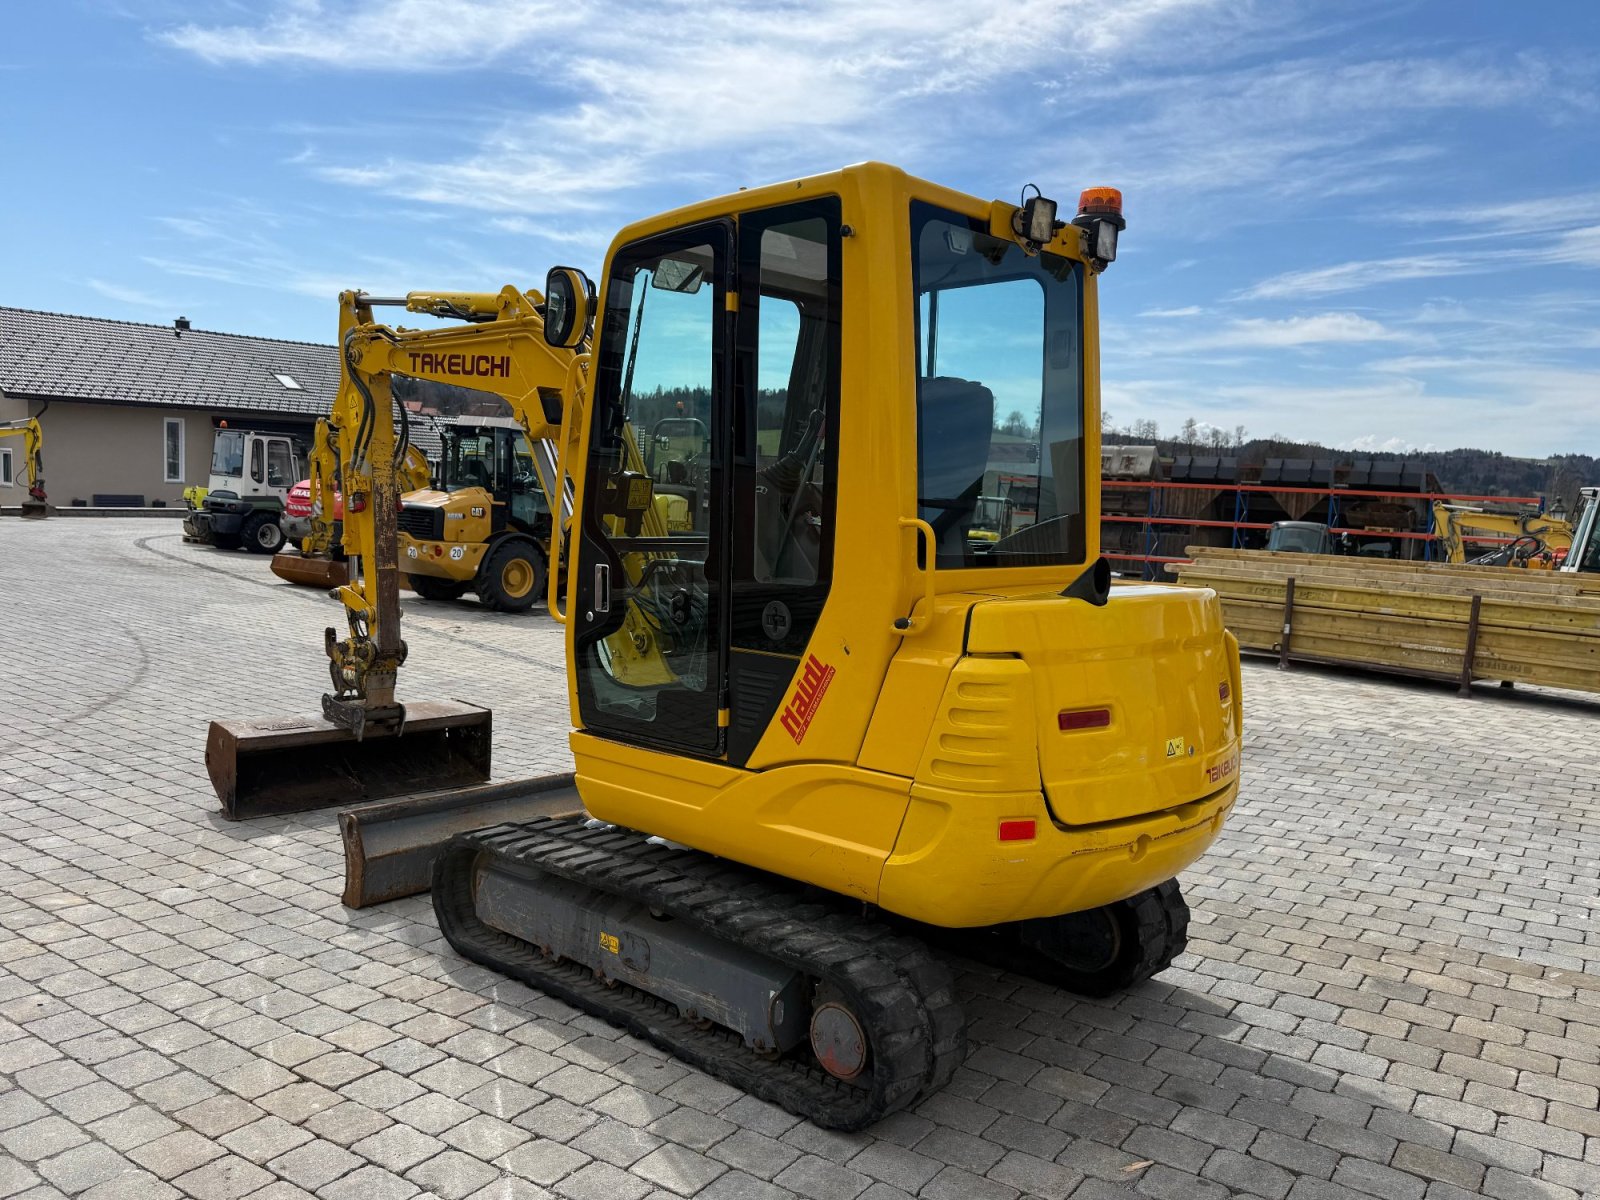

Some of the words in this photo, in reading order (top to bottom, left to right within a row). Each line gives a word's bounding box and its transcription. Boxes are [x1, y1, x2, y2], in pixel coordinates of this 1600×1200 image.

[408, 352, 511, 378] TAKEUCHI
[471, 507, 483, 517] CAT
[409, 548, 417, 558] 20
[452, 548, 462, 558] 20
[780, 653, 829, 740] Haidl
